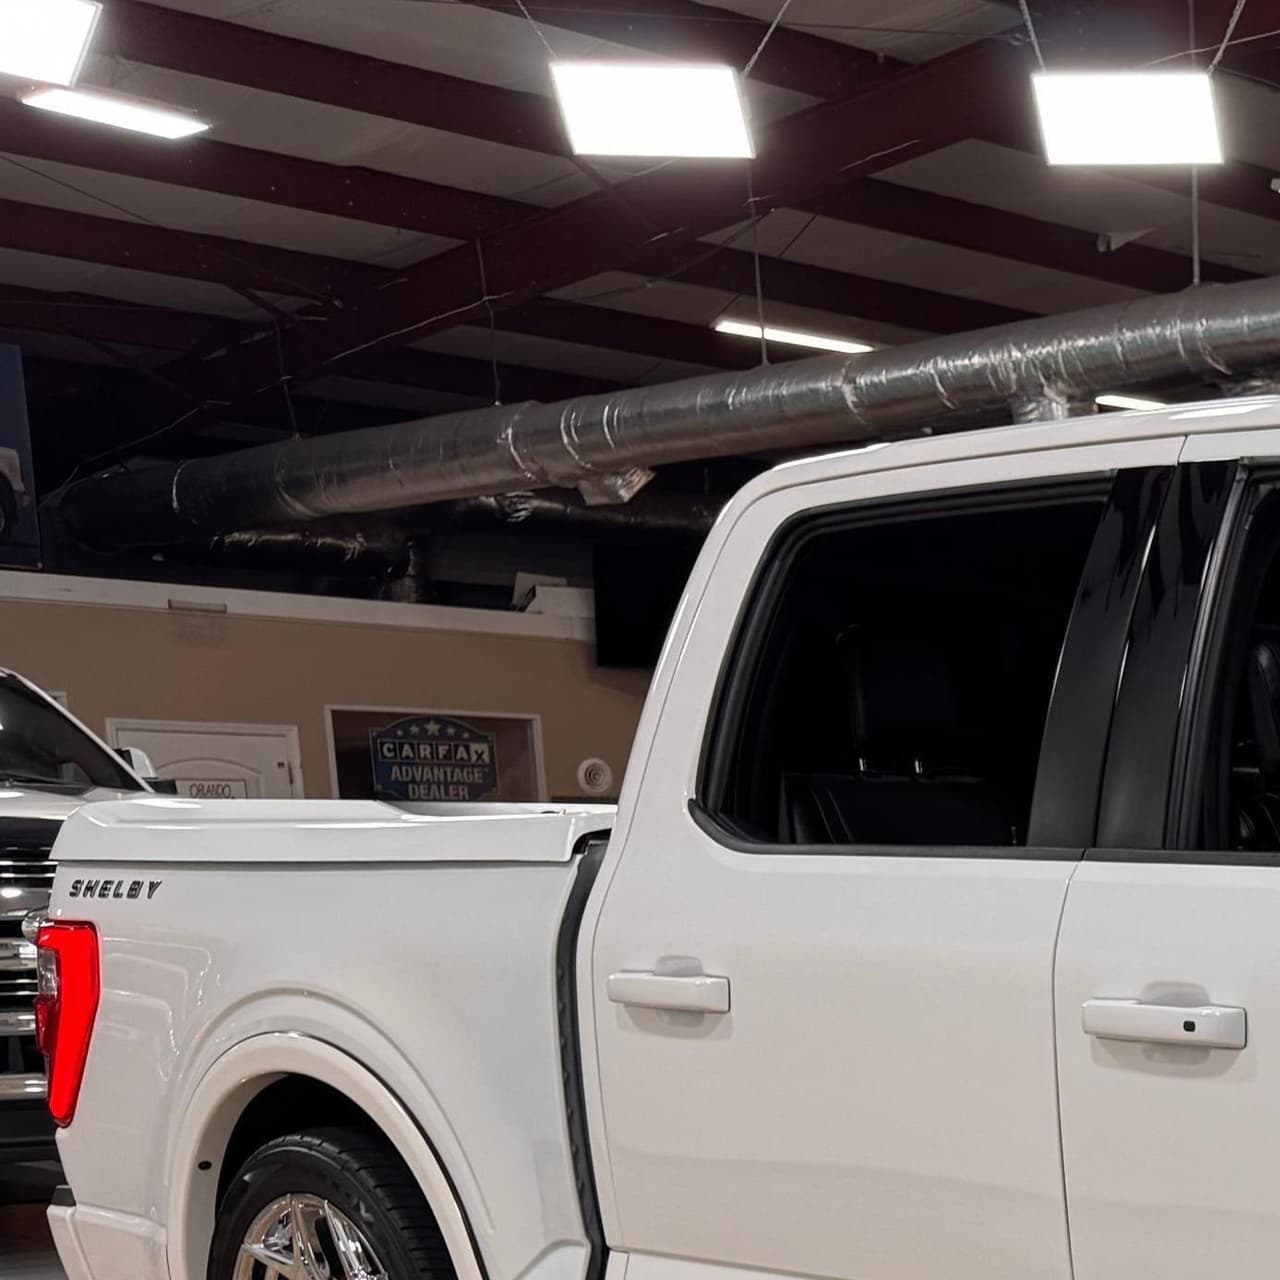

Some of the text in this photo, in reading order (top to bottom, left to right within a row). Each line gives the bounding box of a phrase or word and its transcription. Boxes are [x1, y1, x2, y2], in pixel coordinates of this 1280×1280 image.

[382, 741, 489, 763] CARFAX
[408, 784, 470, 800] DEALER
[69, 879, 162, 899] SHELBY
